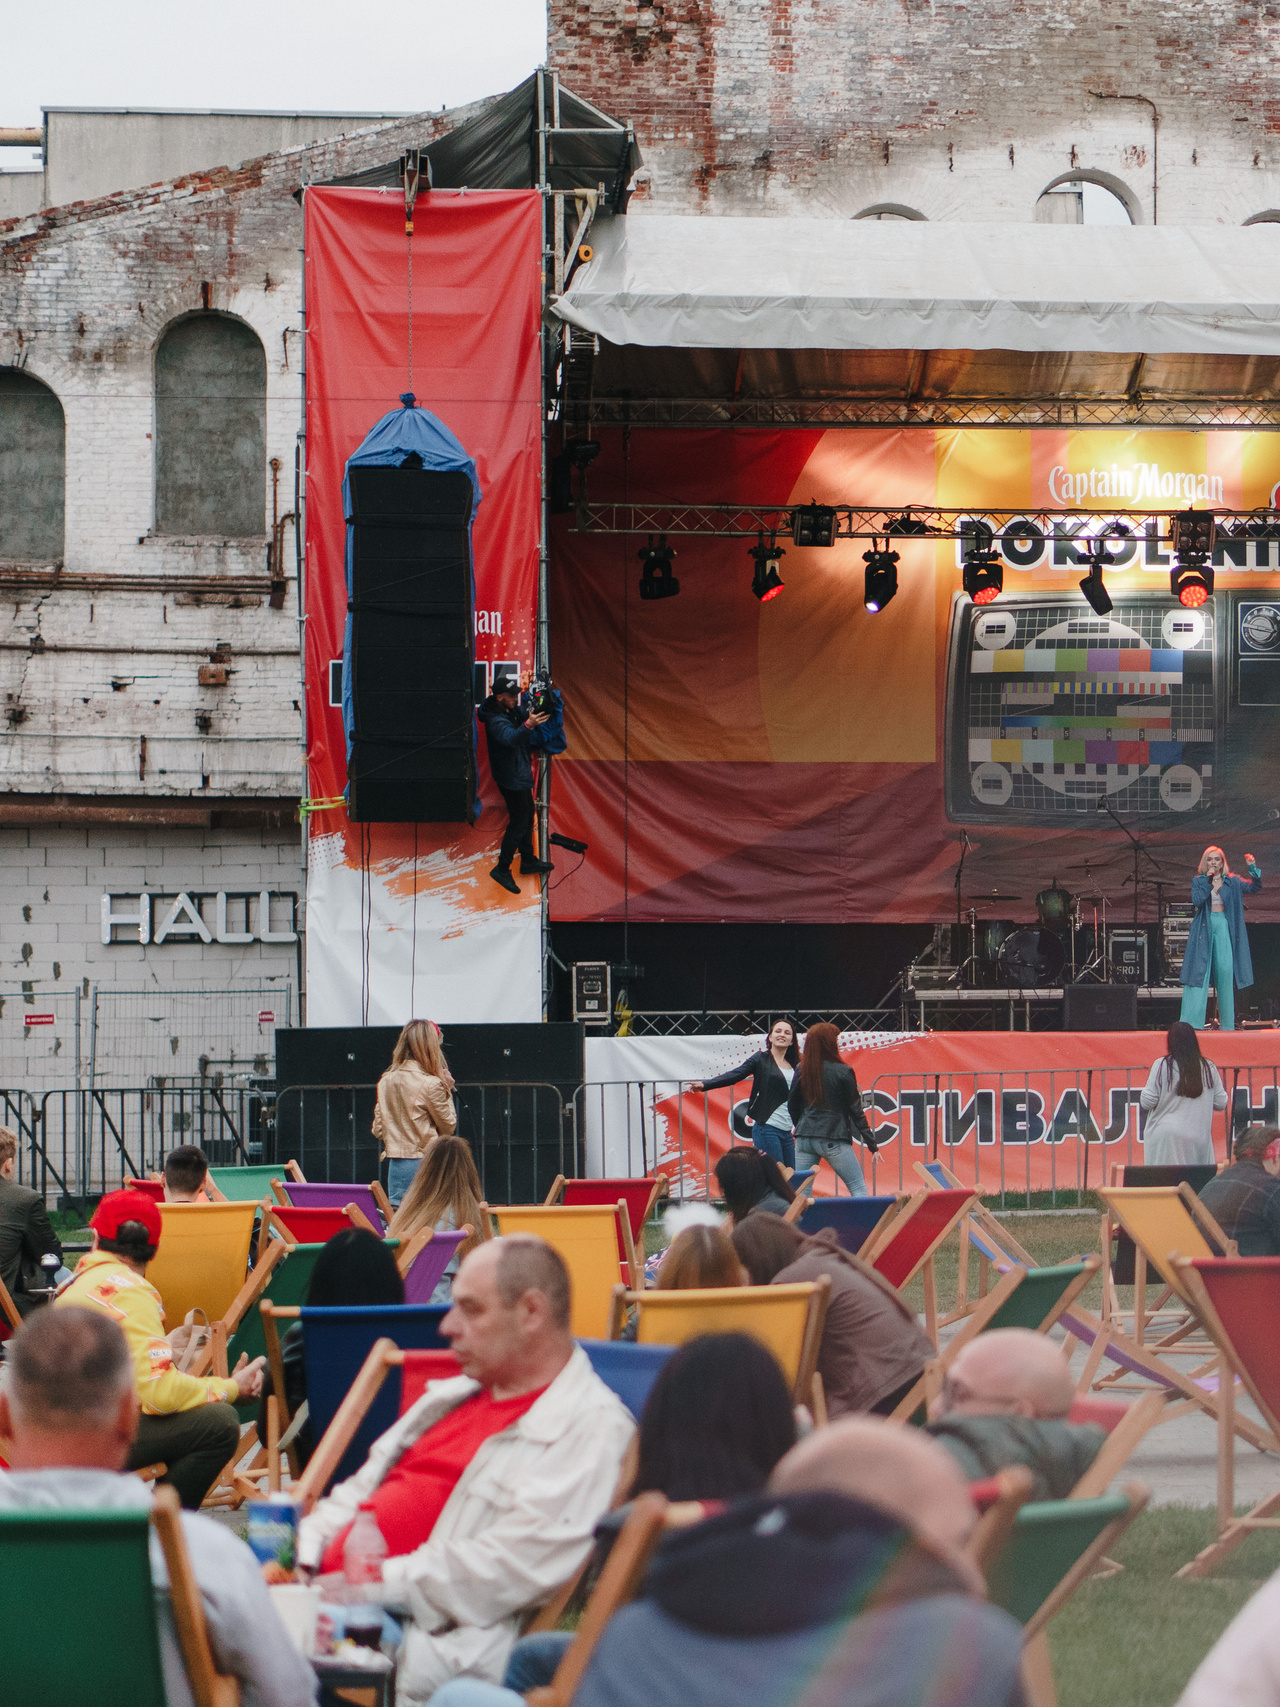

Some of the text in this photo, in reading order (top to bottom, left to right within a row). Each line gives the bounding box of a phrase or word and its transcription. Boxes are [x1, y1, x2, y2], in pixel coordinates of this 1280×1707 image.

[1048, 462, 1224, 505] Captain Morgan
[101, 890, 298, 945] HALL
[729, 1086, 1152, 1148] СТИВАЛ
